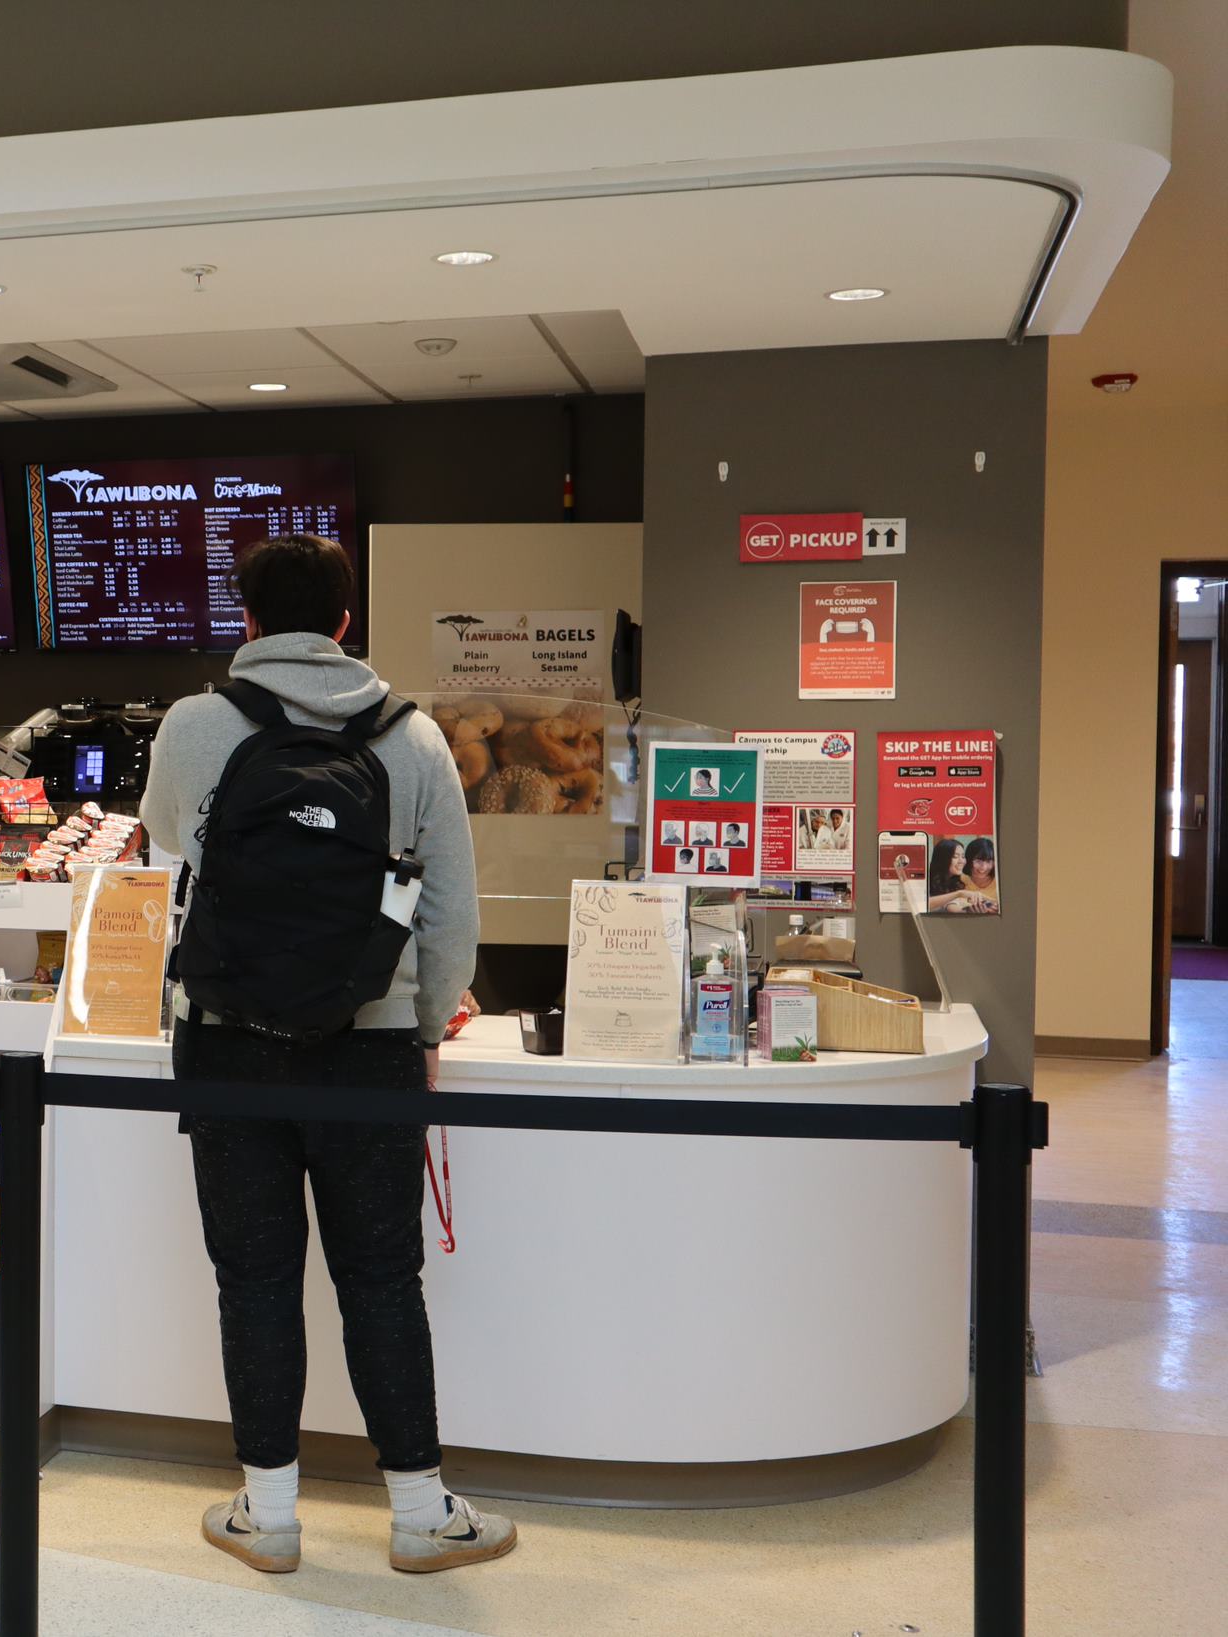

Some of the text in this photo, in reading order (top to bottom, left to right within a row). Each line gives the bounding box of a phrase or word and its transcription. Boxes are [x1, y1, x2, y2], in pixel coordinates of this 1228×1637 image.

[86, 484, 197, 503] SAWUBONA
[749, 532, 858, 548] GET PICKUP
[834, 598, 877, 606] COVERINGS
[829, 606, 867, 615] REQUIRED
[211, 620, 246, 628] Sawubon
[466, 629, 595, 642] SAWUBONA BAGELS
[464, 651, 489, 660] Plain
[532, 650, 587, 661] Long Island
[452, 664, 500, 675] Blueberry
[541, 663, 578, 673] Sesame
[739, 736, 772, 745] Campus
[784, 736, 818, 745] Campus
[885, 740, 993, 753] SKIP THE LINE!
[304, 805, 322, 814] THE
[948, 806, 973, 816] GET
[289, 810, 321, 821] NORTH
[297, 818, 320, 828] FACE
[94, 907, 143, 922] Pamoja
[99, 920, 137, 932] Blend
[599, 925, 657, 937] Tumaini
[604, 938, 648, 950] Blend
[706, 1000, 728, 1009] Purell
